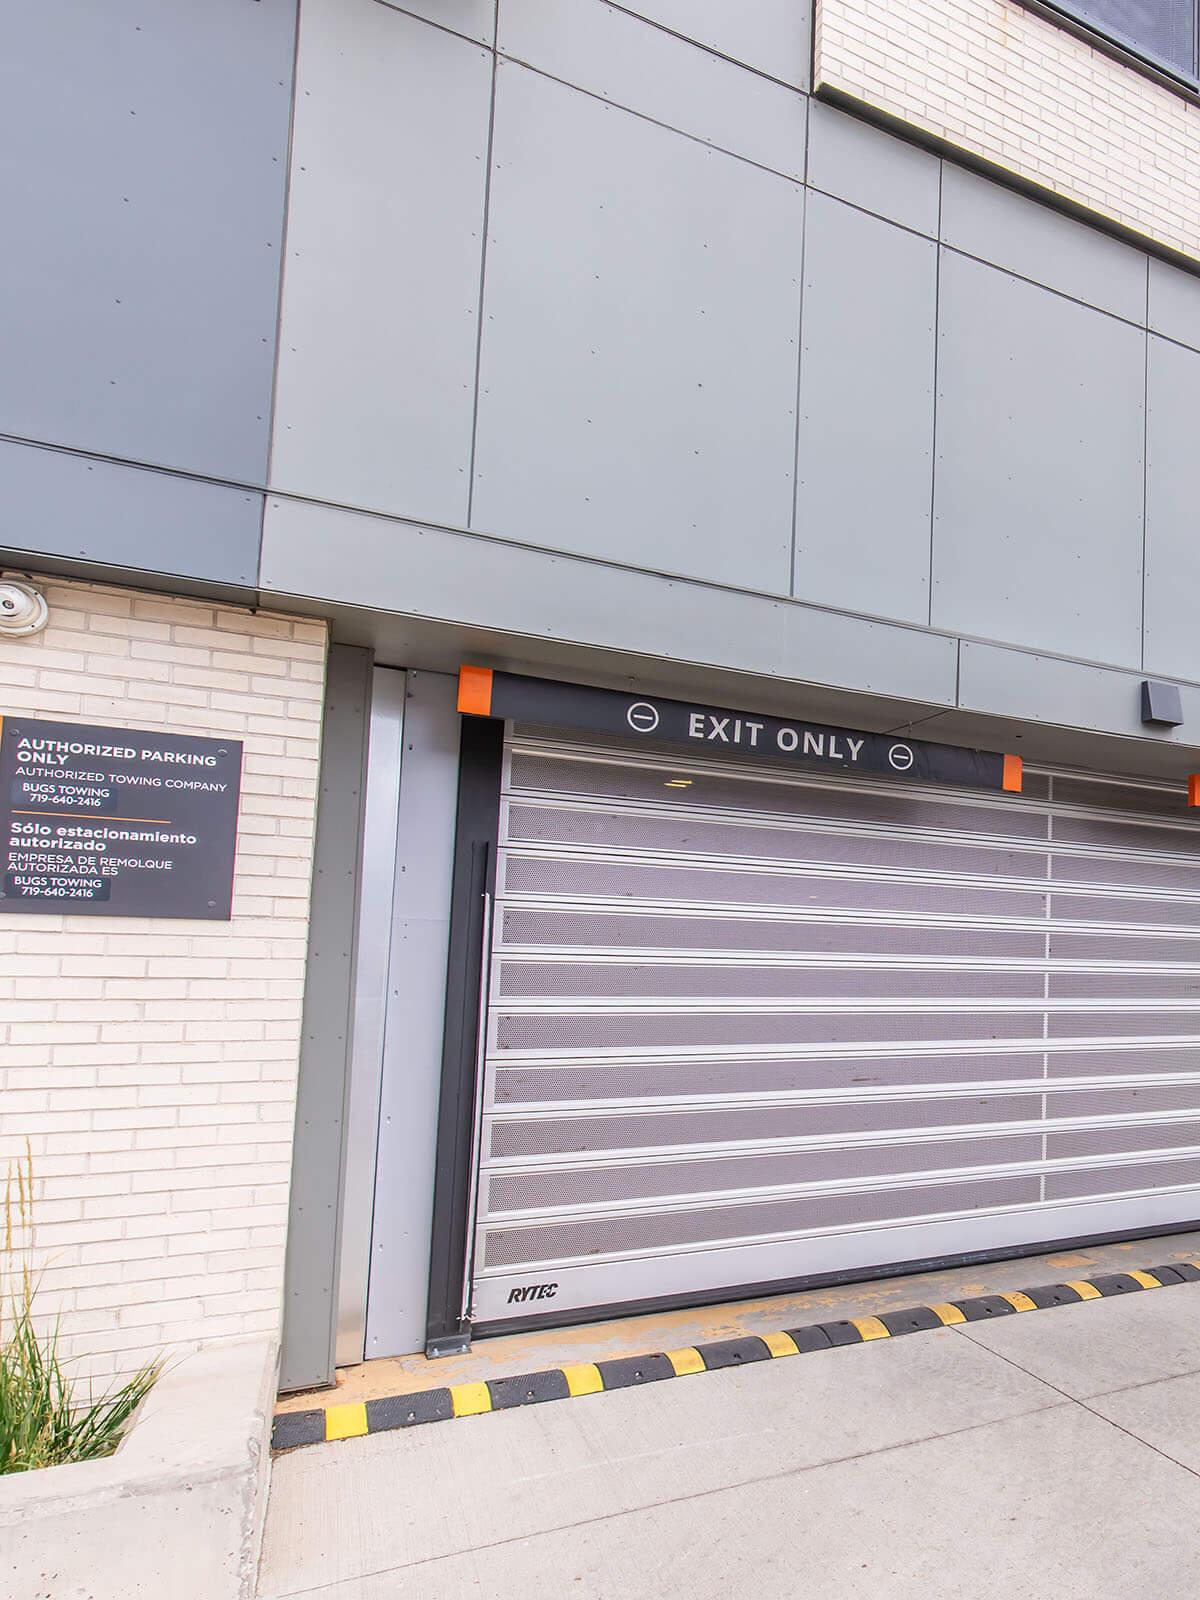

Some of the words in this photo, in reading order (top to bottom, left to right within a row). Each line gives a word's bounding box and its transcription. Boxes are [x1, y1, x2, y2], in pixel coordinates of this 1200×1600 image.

[689, 712, 764, 747] EXIT
[777, 726, 865, 762] ONLY
[16, 751, 69, 766] ONLY
[17, 738, 136, 759] AUTHORIZED
[141, 750, 217, 767] PARKING
[15, 767, 105, 782] AUTHORIZED
[108, 774, 162, 787] TOWING
[165, 779, 228, 792] COMPANY
[22, 782, 56, 794] BUGS
[58, 786, 110, 798] TOWING
[29, 794, 101, 807] 719-640-2416
[10, 822, 51, 836] Sólo
[56, 826, 197, 845] estacionamiento
[9, 837, 106, 852] autorizado
[7, 862, 98, 875] AUTORIZADA
[102, 866, 119, 876] ES
[8, 852, 73, 865] EMPRESA
[78, 856, 96, 866] DE
[100, 858, 173, 870] REMOLQUE
[14, 876, 48, 886] BUGS
[50, 877, 102, 888] TOWING
[21, 887, 94, 898] 719-640-2416
[507, 1282, 559, 1304] RYTEC
